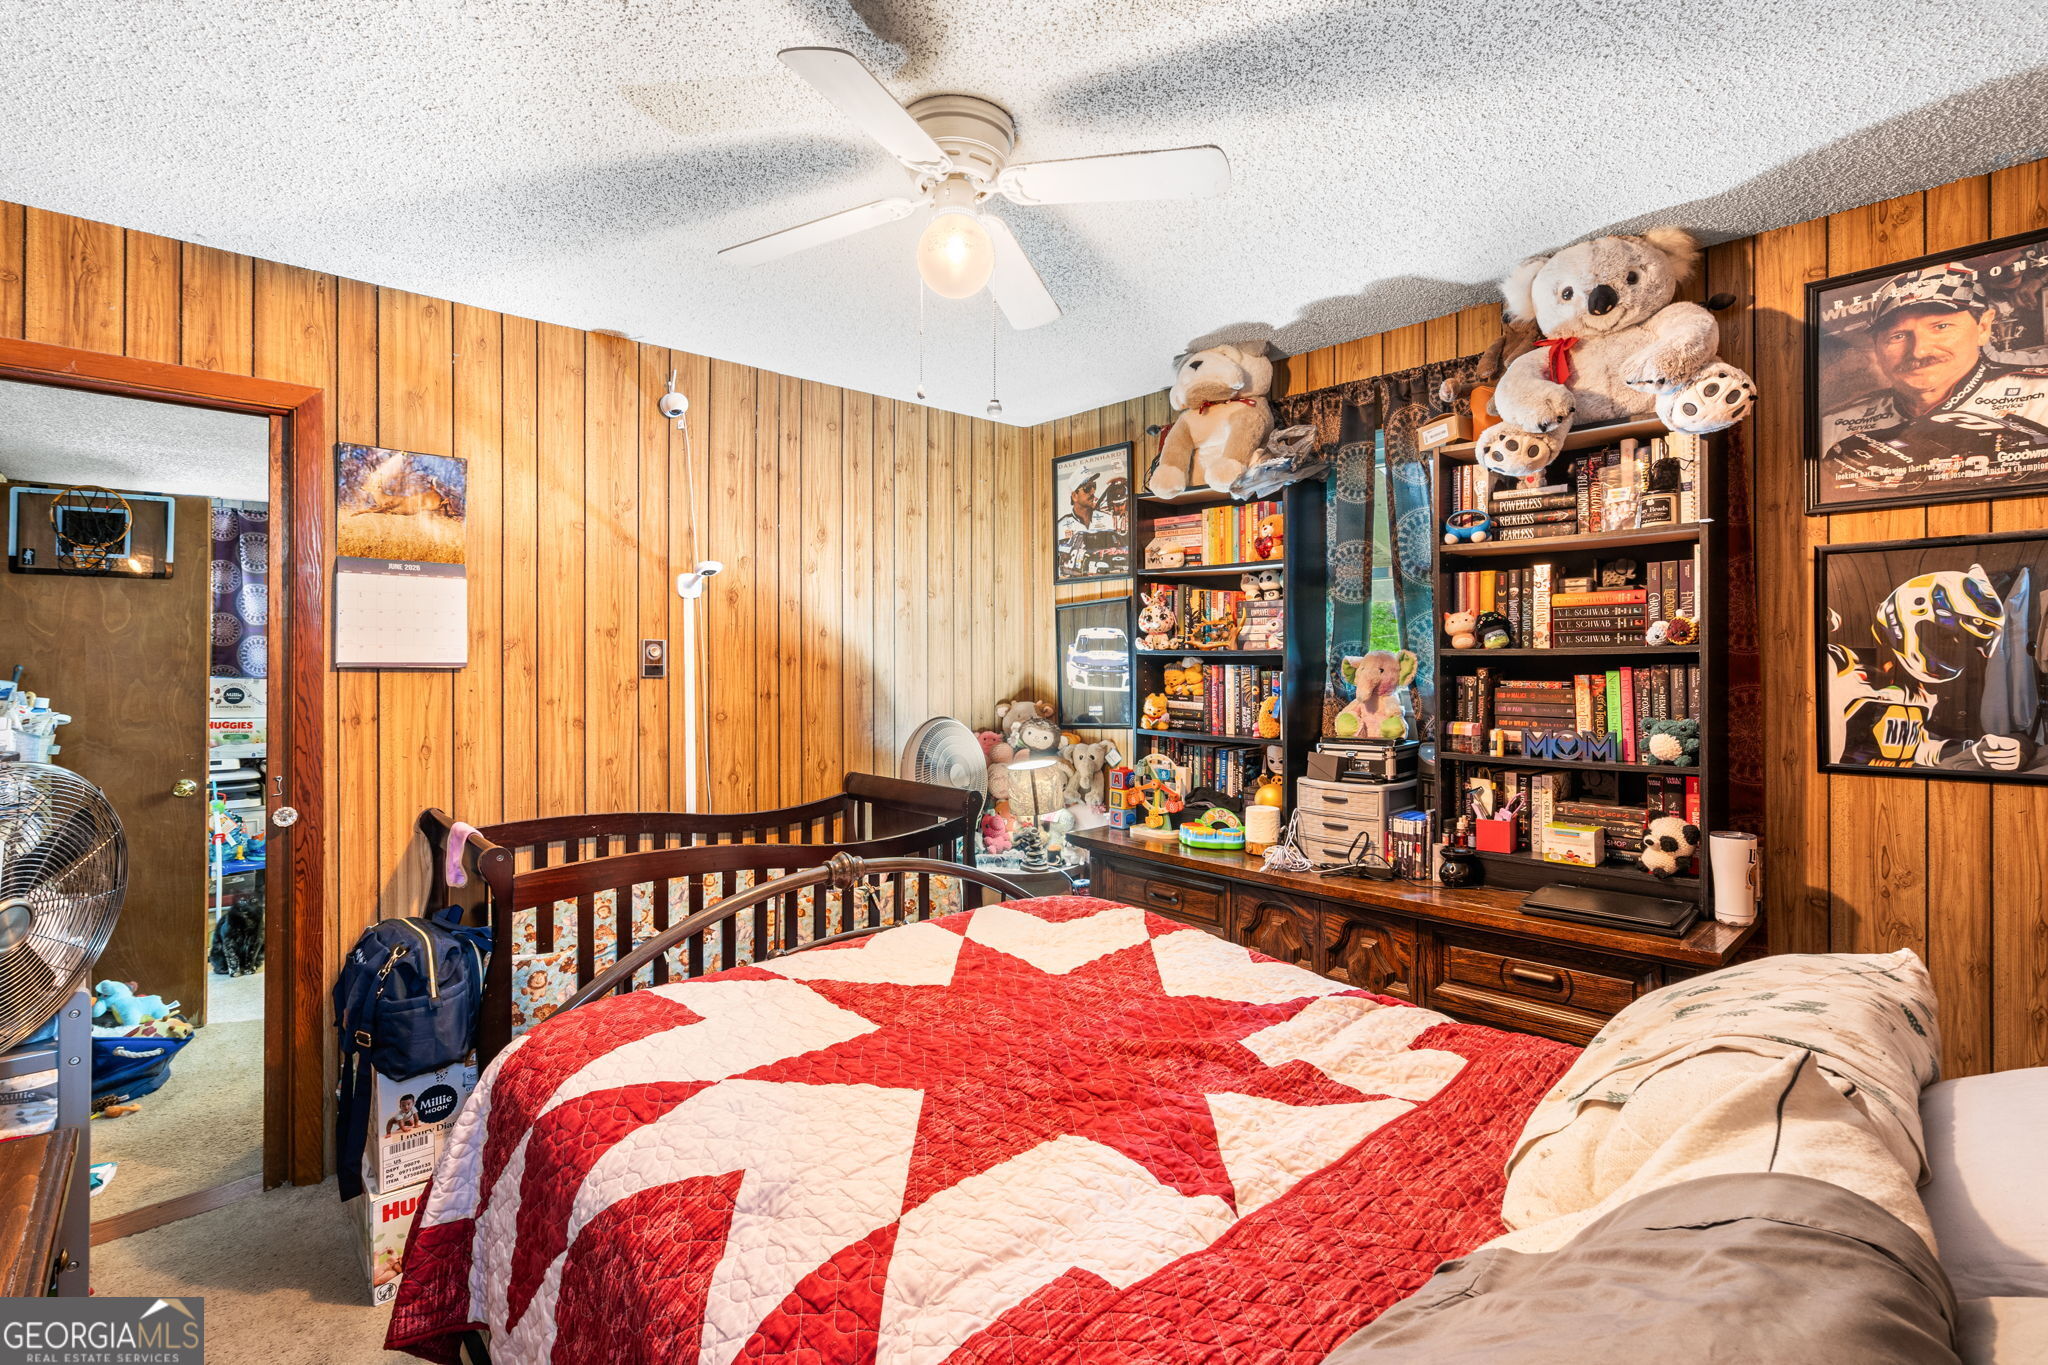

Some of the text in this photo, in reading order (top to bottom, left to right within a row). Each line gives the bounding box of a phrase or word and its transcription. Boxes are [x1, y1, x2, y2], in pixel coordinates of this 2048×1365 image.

[1974, 392, 2045, 404] Goodwrench
[1991, 403, 2024, 411] Service
[1834, 412, 1894, 425] Goodwrench
[1846, 423, 1876, 432] Service
[1058, 449, 1127, 470] DALE EARNHARDT
[1577, 474, 1589, 521] BELLADONNA
[1499, 498, 1542, 512] POWERLESS
[1499, 513, 1535, 527] RECKLESS
[1499, 527, 1535, 541] FEARLESS
[1574, 608, 1610, 616] SCHWAB
[1648, 592, 1660, 620] CARAVAL
[1575, 620, 1611, 628] SCHWAB
[1575, 635, 1611, 643] SCHWAB
[1658, 694, 1666, 721] HEMLOC
[209, 721, 254, 729] HUGGIES
[1595, 711, 1607, 740] FIRELIGH
[1521, 727, 1617, 762] MOM
[1113, 774, 1120, 784] A
[1113, 813, 1119, 823] C
[1597, 809, 1630, 819] CROWS
[419, 1093, 453, 1110] Millie
[424, 1103, 448, 1115] MOON
[386, 1166, 400, 1174] DEPT
[386, 1177, 399, 1185] ITEM
[382, 1194, 421, 1223] HU
